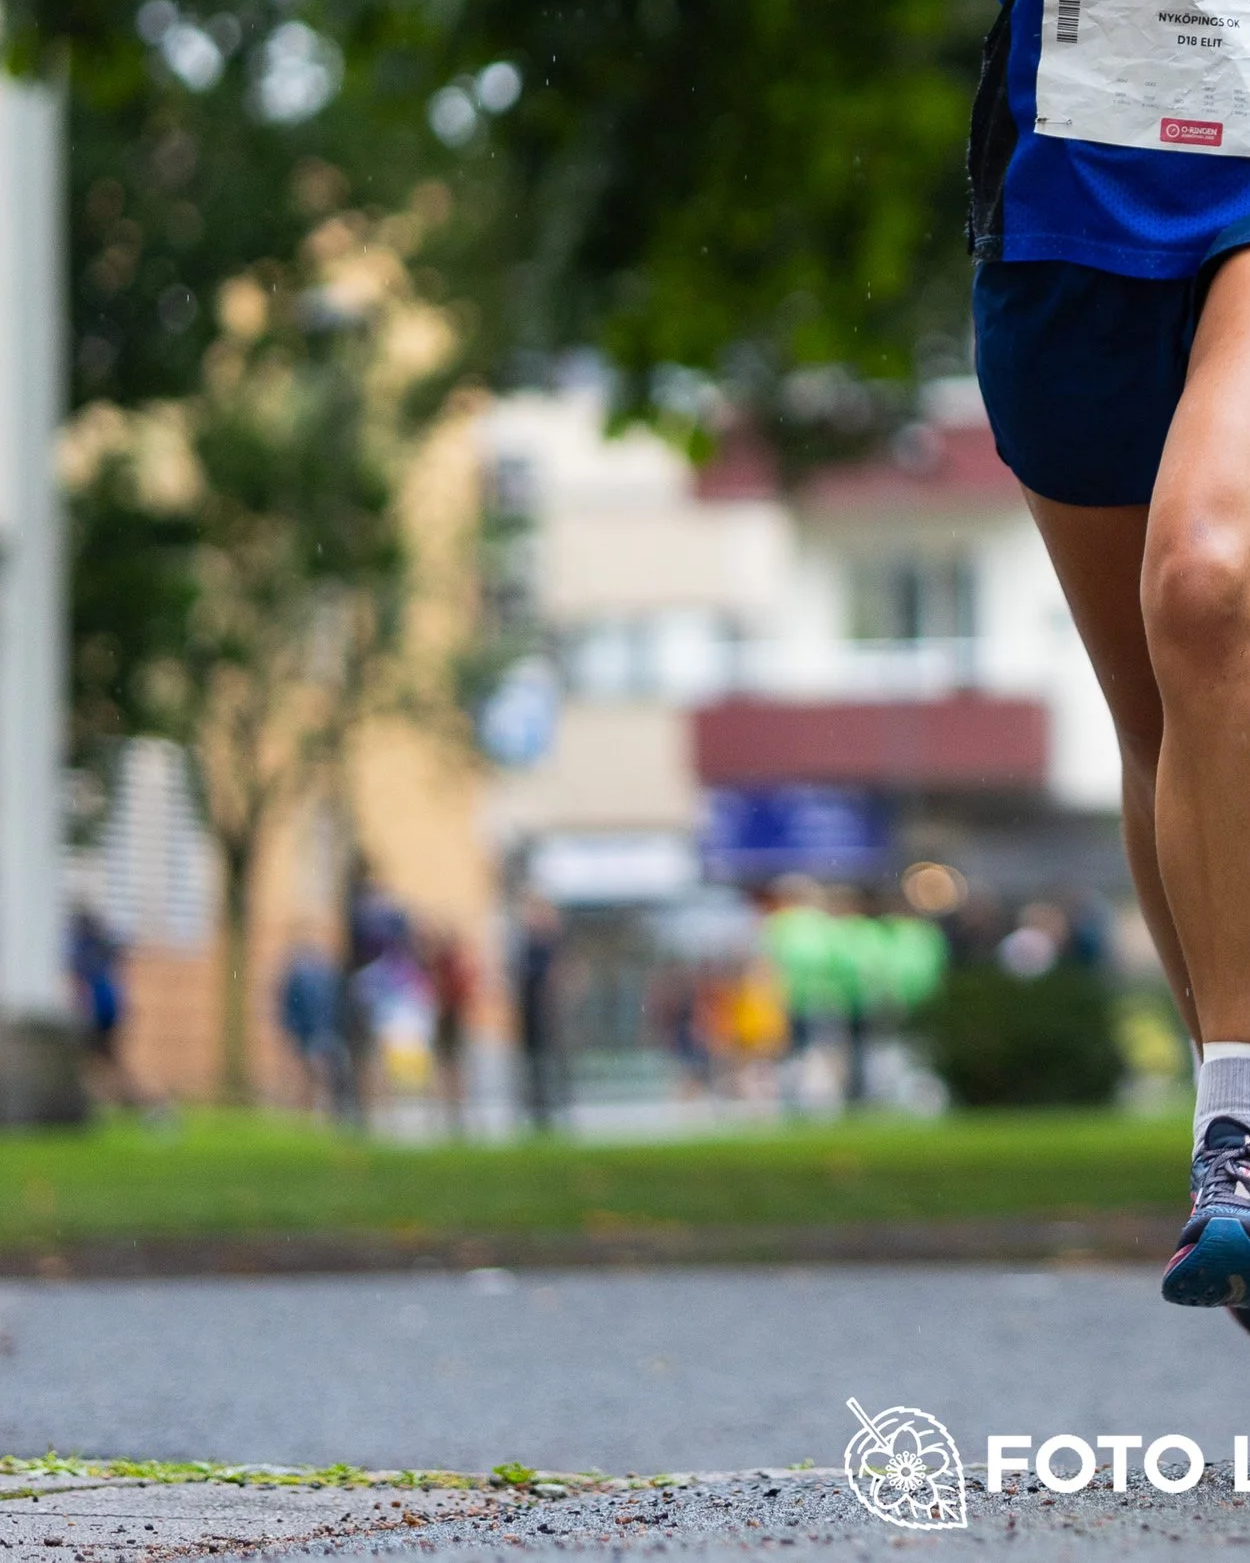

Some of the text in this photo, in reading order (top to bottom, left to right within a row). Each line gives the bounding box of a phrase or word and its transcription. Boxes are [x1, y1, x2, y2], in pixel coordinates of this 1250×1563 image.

[1158, 12, 1240, 28] NYKÖPINGS OK
[1177, 35, 1222, 47] D18 ELIT
